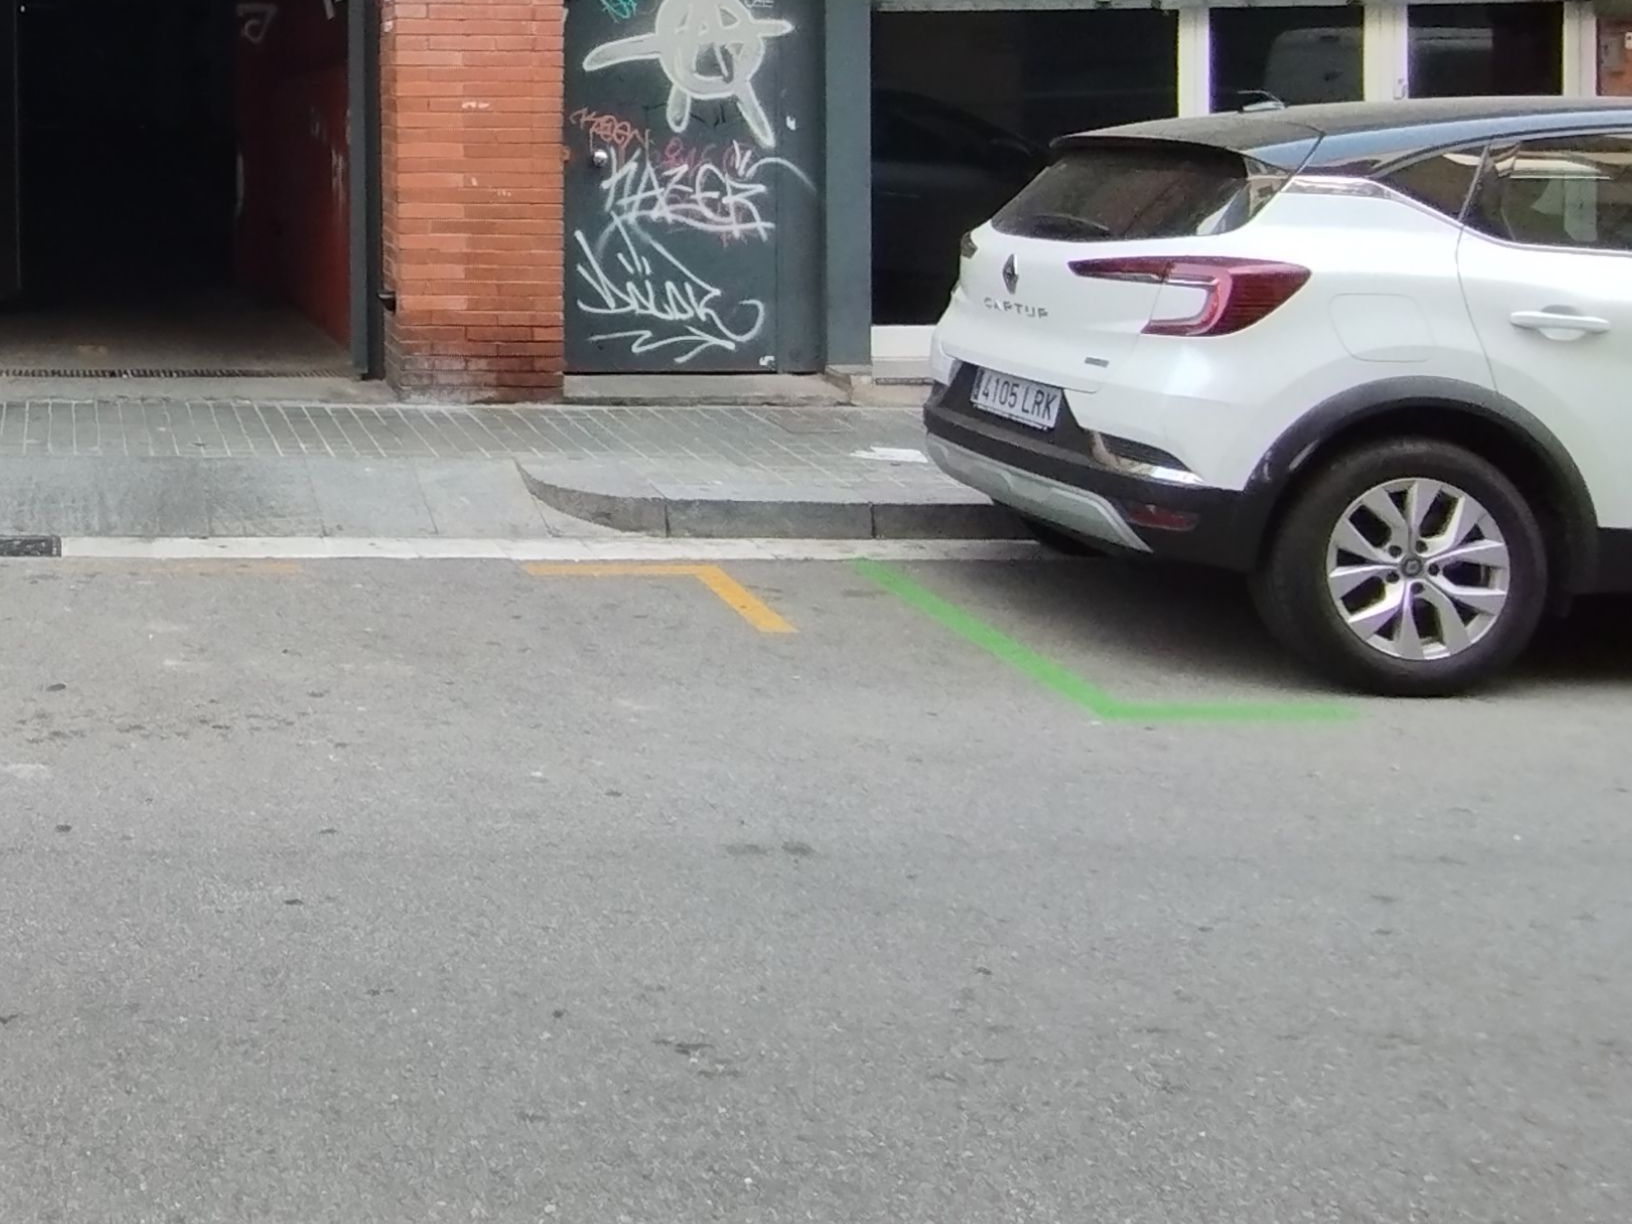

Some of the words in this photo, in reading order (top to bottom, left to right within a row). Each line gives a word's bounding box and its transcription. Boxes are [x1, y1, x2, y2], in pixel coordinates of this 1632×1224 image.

[983, 296, 1049, 319] CAPTUR
[981, 374, 1020, 409] 4105
[1021, 385, 1057, 421] LRK
